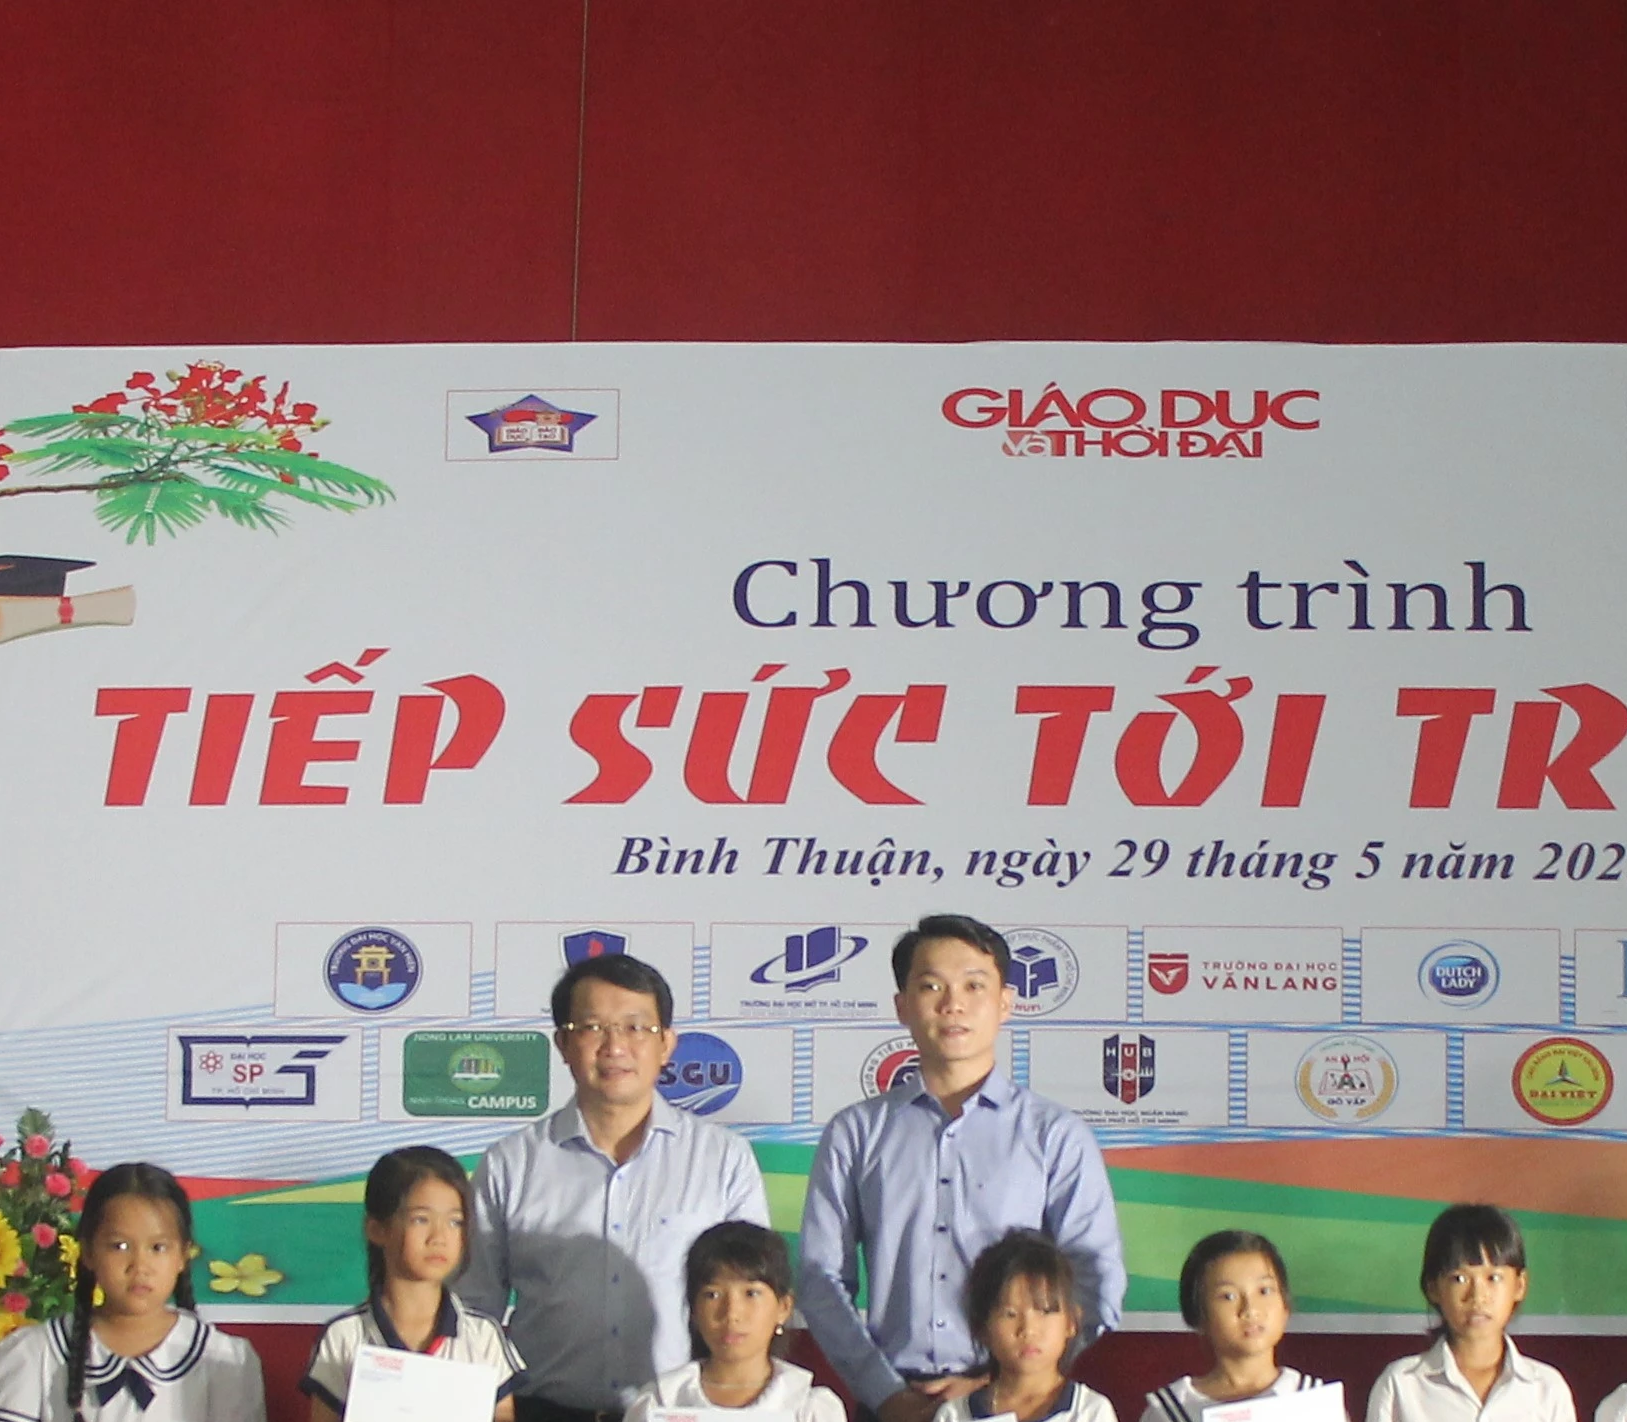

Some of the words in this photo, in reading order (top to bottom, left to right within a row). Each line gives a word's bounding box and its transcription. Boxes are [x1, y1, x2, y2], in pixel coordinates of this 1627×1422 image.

[941, 381, 1147, 429] GIÁO
[733, 558, 1202, 650] Chương
[1237, 560, 1533, 631] trình
[95, 648, 505, 806] TIẾP
[563, 664, 947, 805] SỨC
[1015, 666, 1326, 807] TỚI
[614, 837, 738, 874] Bình
[765, 838, 943, 886] Thuận,
[966, 842, 1090, 889] ngày
[1109, 839, 1170, 877] 29
[1186, 840, 1339, 890] tháng
[1355, 842, 1384, 878] 5
[1401, 842, 1514, 880] năm
[1203, 959, 1268, 972] TRƯỜNG
[1305, 961, 1339, 973] HỌC
[1436, 965, 1482, 979] DUTCH
[1440, 977, 1477, 990] LADY
[474, 1033, 539, 1042] UNIVERSITY
[233, 1063, 264, 1084] SP
[658, 1061, 732, 1087] SGU
[467, 1095, 537, 1110] CAMPUS
